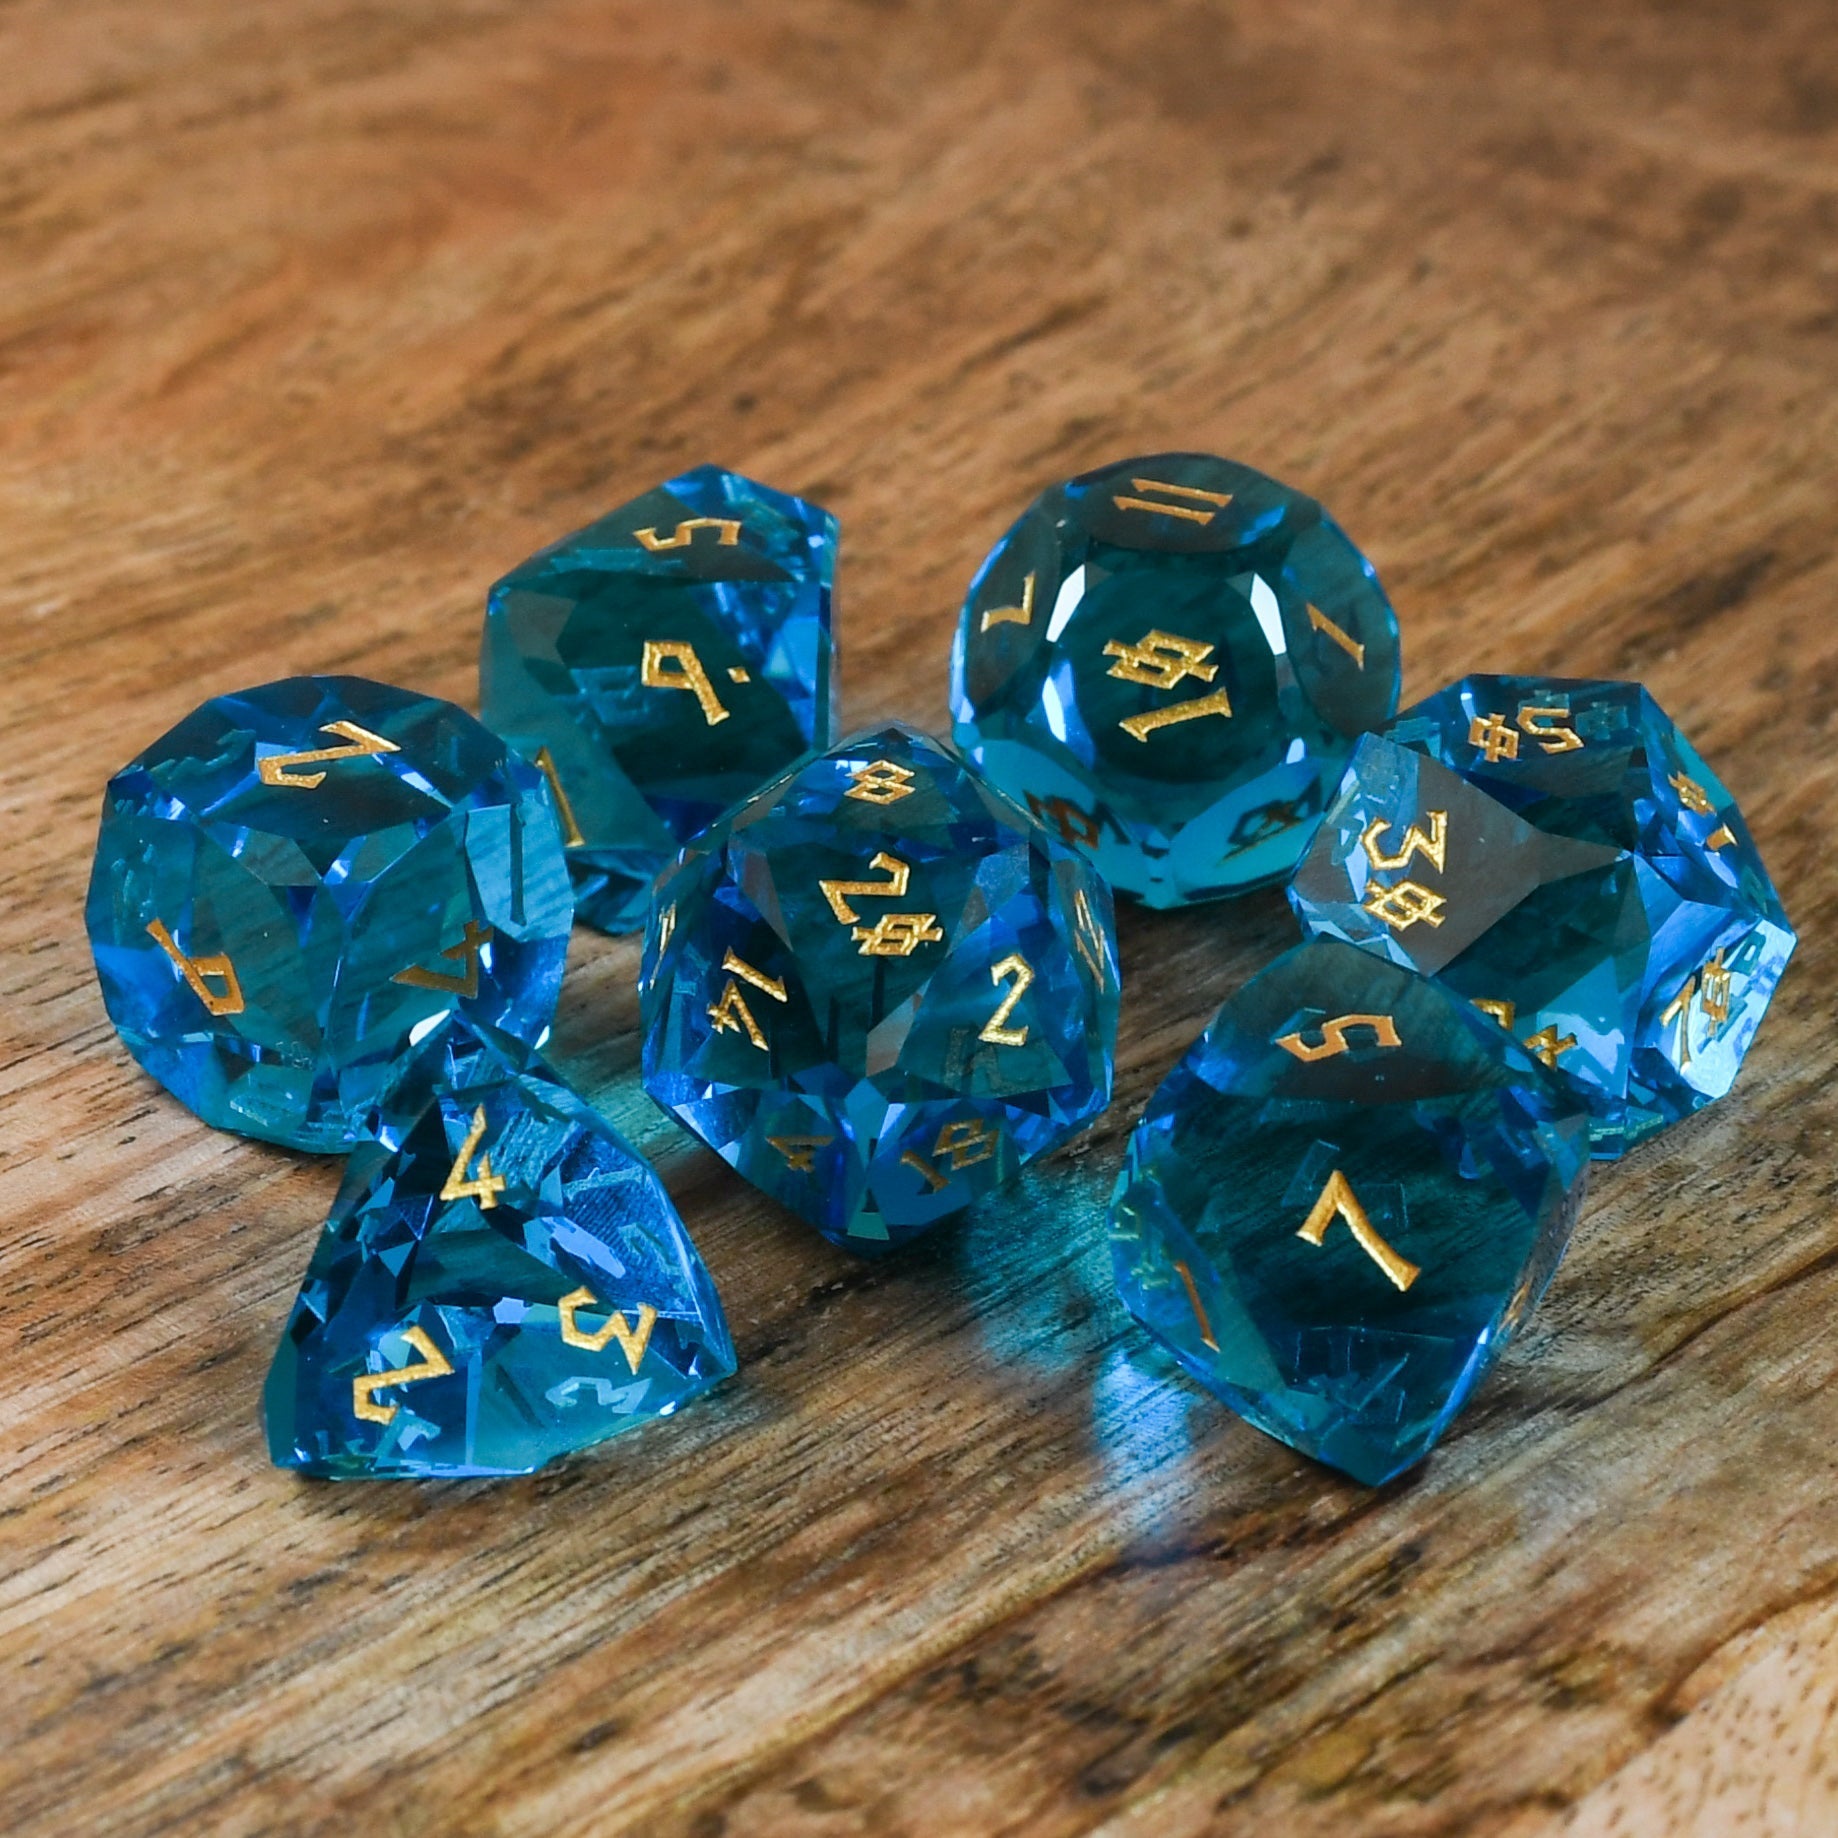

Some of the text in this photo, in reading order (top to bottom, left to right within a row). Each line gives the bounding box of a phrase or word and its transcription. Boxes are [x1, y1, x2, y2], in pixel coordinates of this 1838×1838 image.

[633, 517, 742, 552] 5
[1112, 477, 1234, 526] 11
[980, 571, 1036, 634] 7
[1102, 628, 1233, 743] 10
[257, 719, 402, 790] 2
[1467, 705, 1585, 763] 50
[534, 746, 586, 847] 1
[843, 759, 916, 806] 8
[818, 851, 944, 957] 20
[1360, 809, 1448, 931] 30
[389, 919, 495, 1000] 4
[705, 944, 789, 1052] 14
[978, 952, 1036, 1048] 2
[1275, 1013, 1403, 1062] 5
[439, 1103, 507, 1211] 4
[900, 1117, 1000, 1193] 18
[1296, 1168, 1423, 1292] 7
[353, 1325, 456, 1425] 2
[558, 1285, 659, 1376] 3
